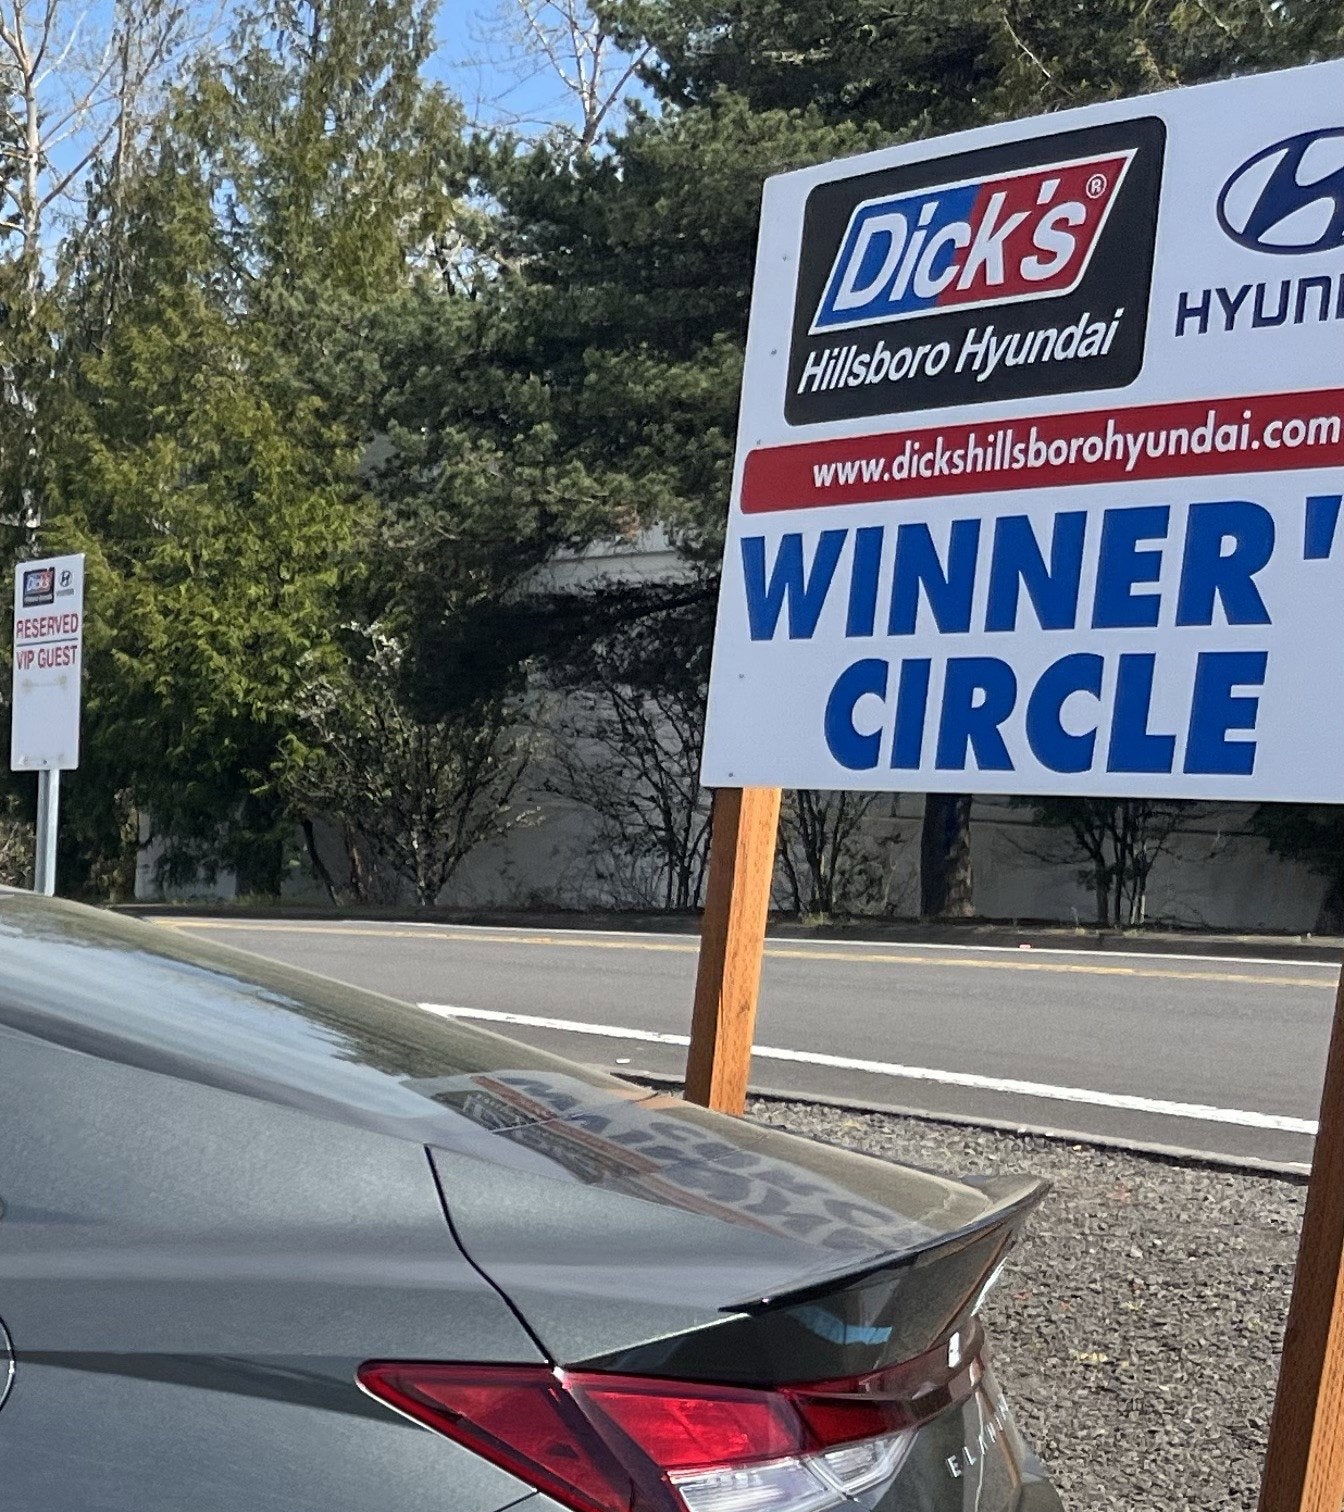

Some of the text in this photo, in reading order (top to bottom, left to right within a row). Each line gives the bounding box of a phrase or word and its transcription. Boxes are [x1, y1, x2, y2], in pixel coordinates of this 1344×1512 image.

[833, 178, 1086, 312] Dick's
[1175, 273, 1344, 338] HYUN
[797, 307, 1125, 395] Hillsboro Hyundai
[812, 409, 1341, 489] www.dickshillsborohyundai.com
[16, 613, 79, 639] RESERVED
[16, 645, 78, 670] VIP GUEST
[824, 650, 1269, 777] CIRCLE
